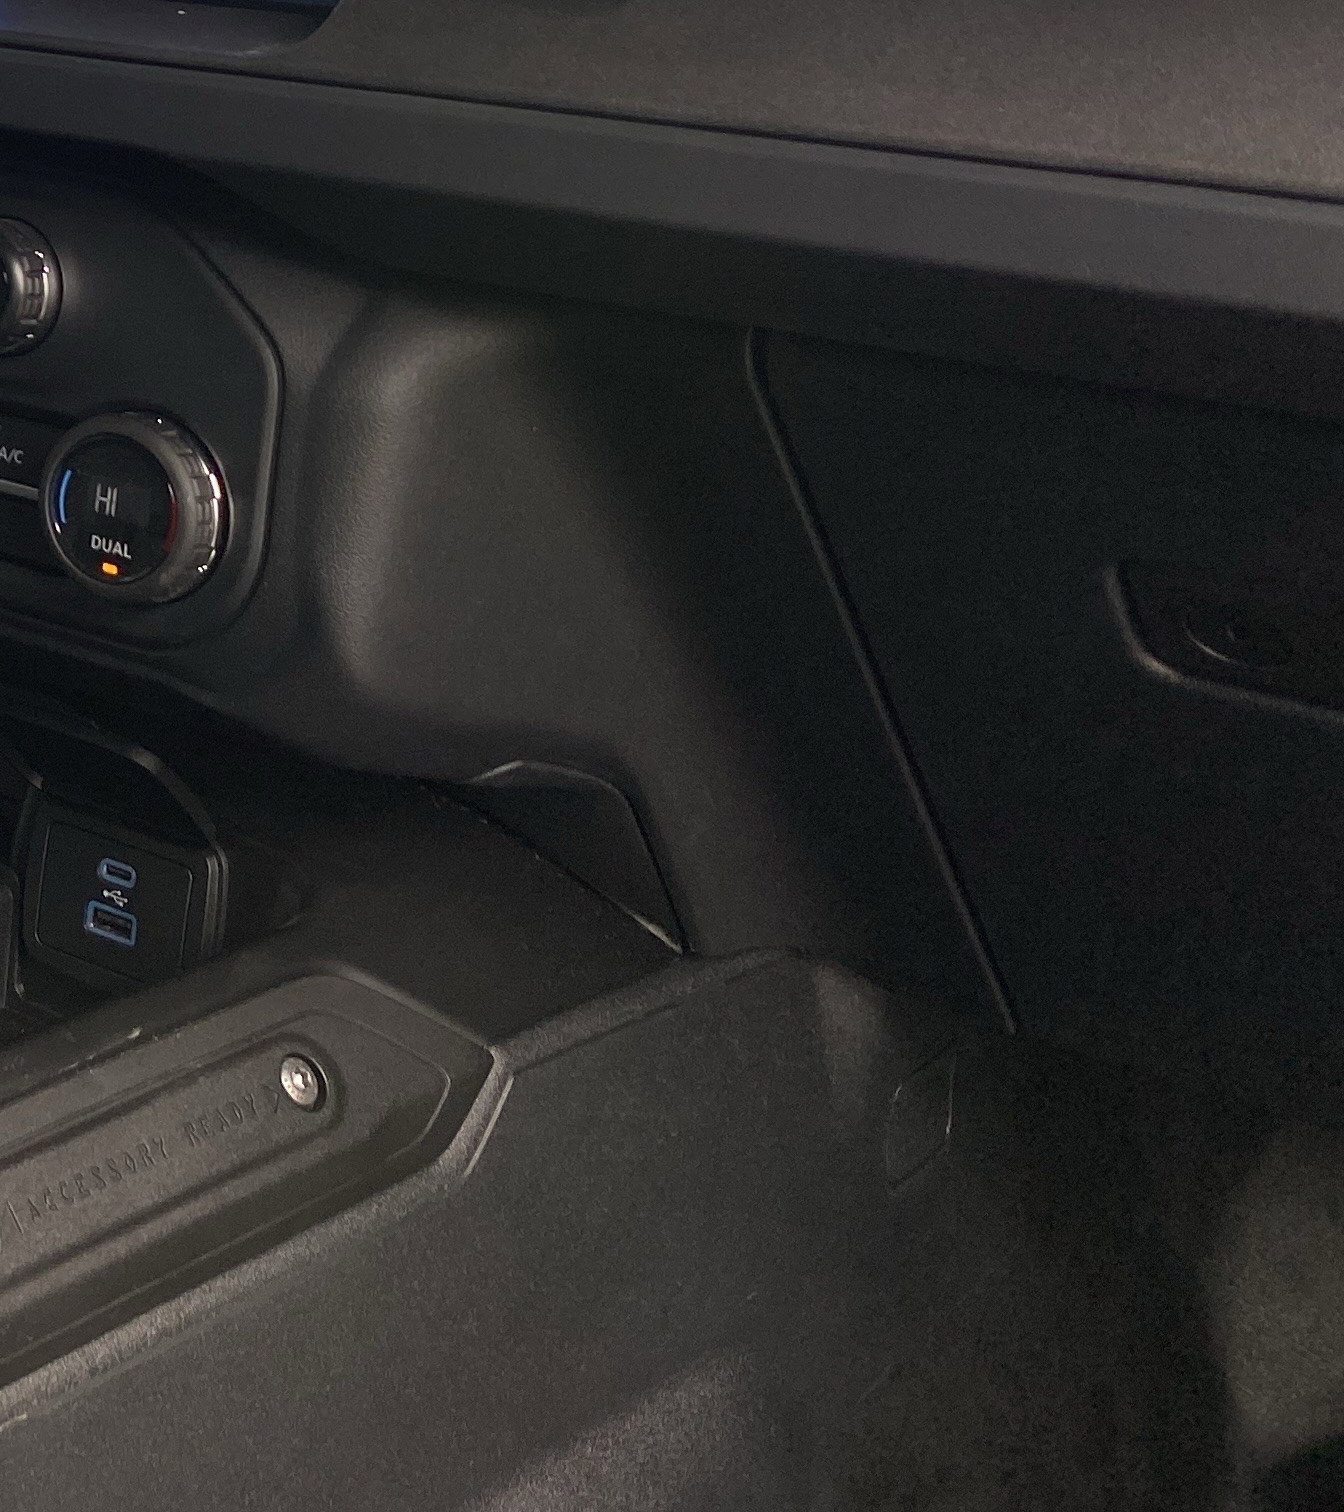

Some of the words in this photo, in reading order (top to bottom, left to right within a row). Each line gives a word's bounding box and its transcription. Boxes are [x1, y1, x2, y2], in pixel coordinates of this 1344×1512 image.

[95, 483, 119, 518] HI
[90, 534, 132, 560] DUAL
[27, 1136, 170, 1224] ACCESSORY
[182, 1092, 260, 1149] READY
